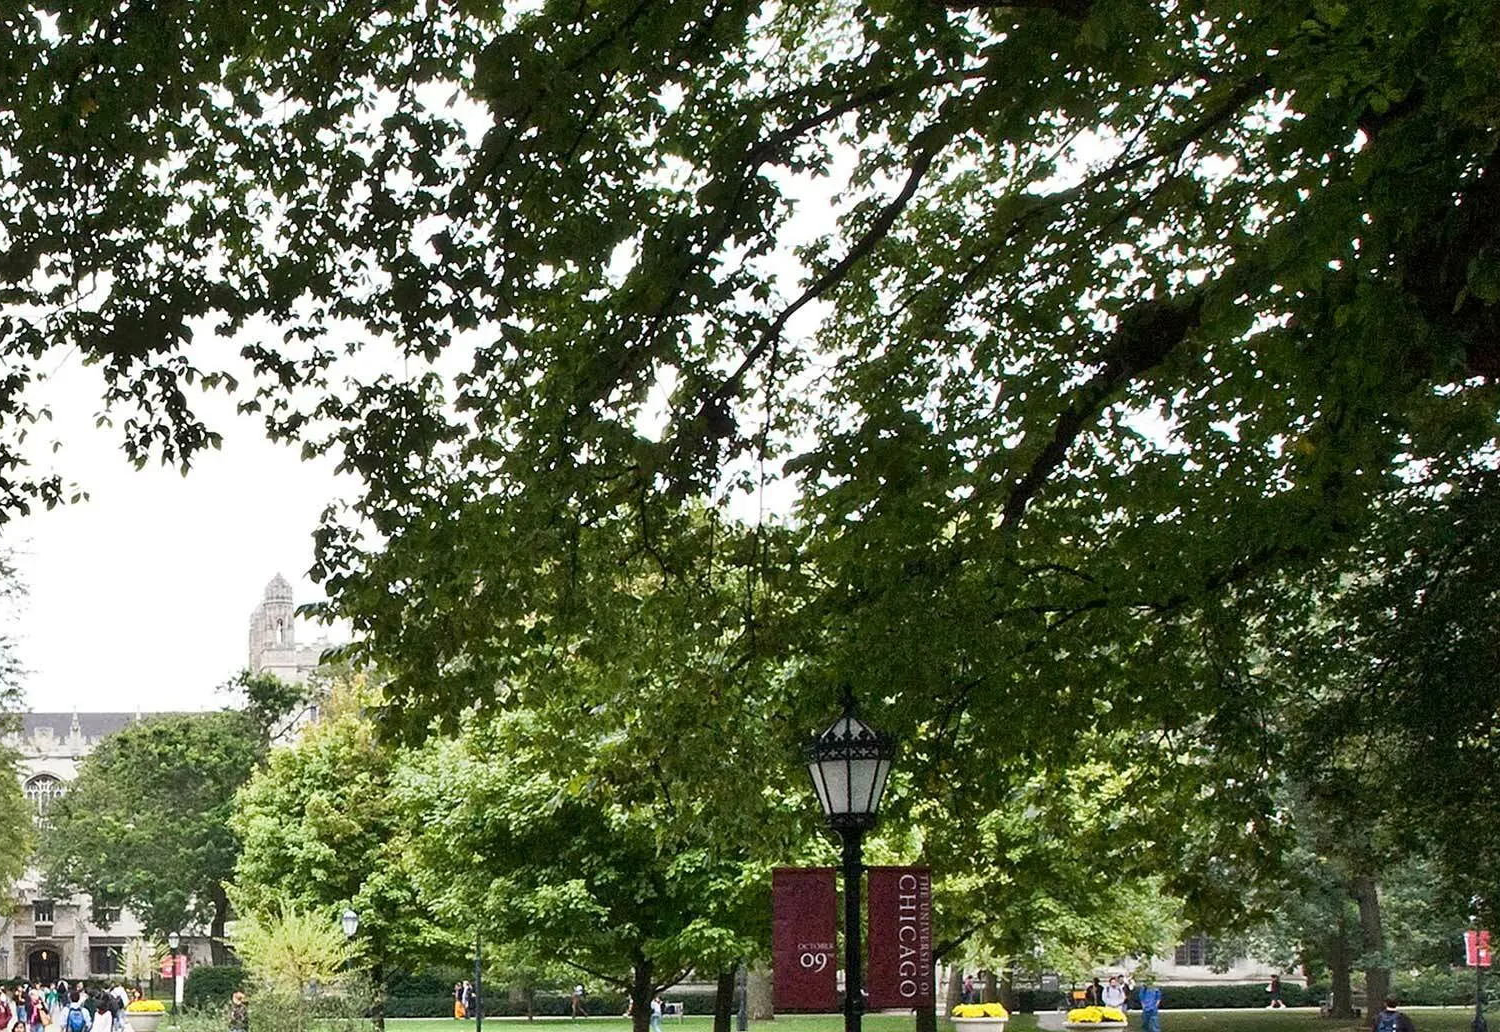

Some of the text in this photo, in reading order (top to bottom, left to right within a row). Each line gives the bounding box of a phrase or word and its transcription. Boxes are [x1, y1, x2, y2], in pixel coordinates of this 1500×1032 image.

[919, 874, 930, 898] THE
[898, 874, 918, 998] CHICAGO
[919, 903, 930, 977] UNIVERSITY
